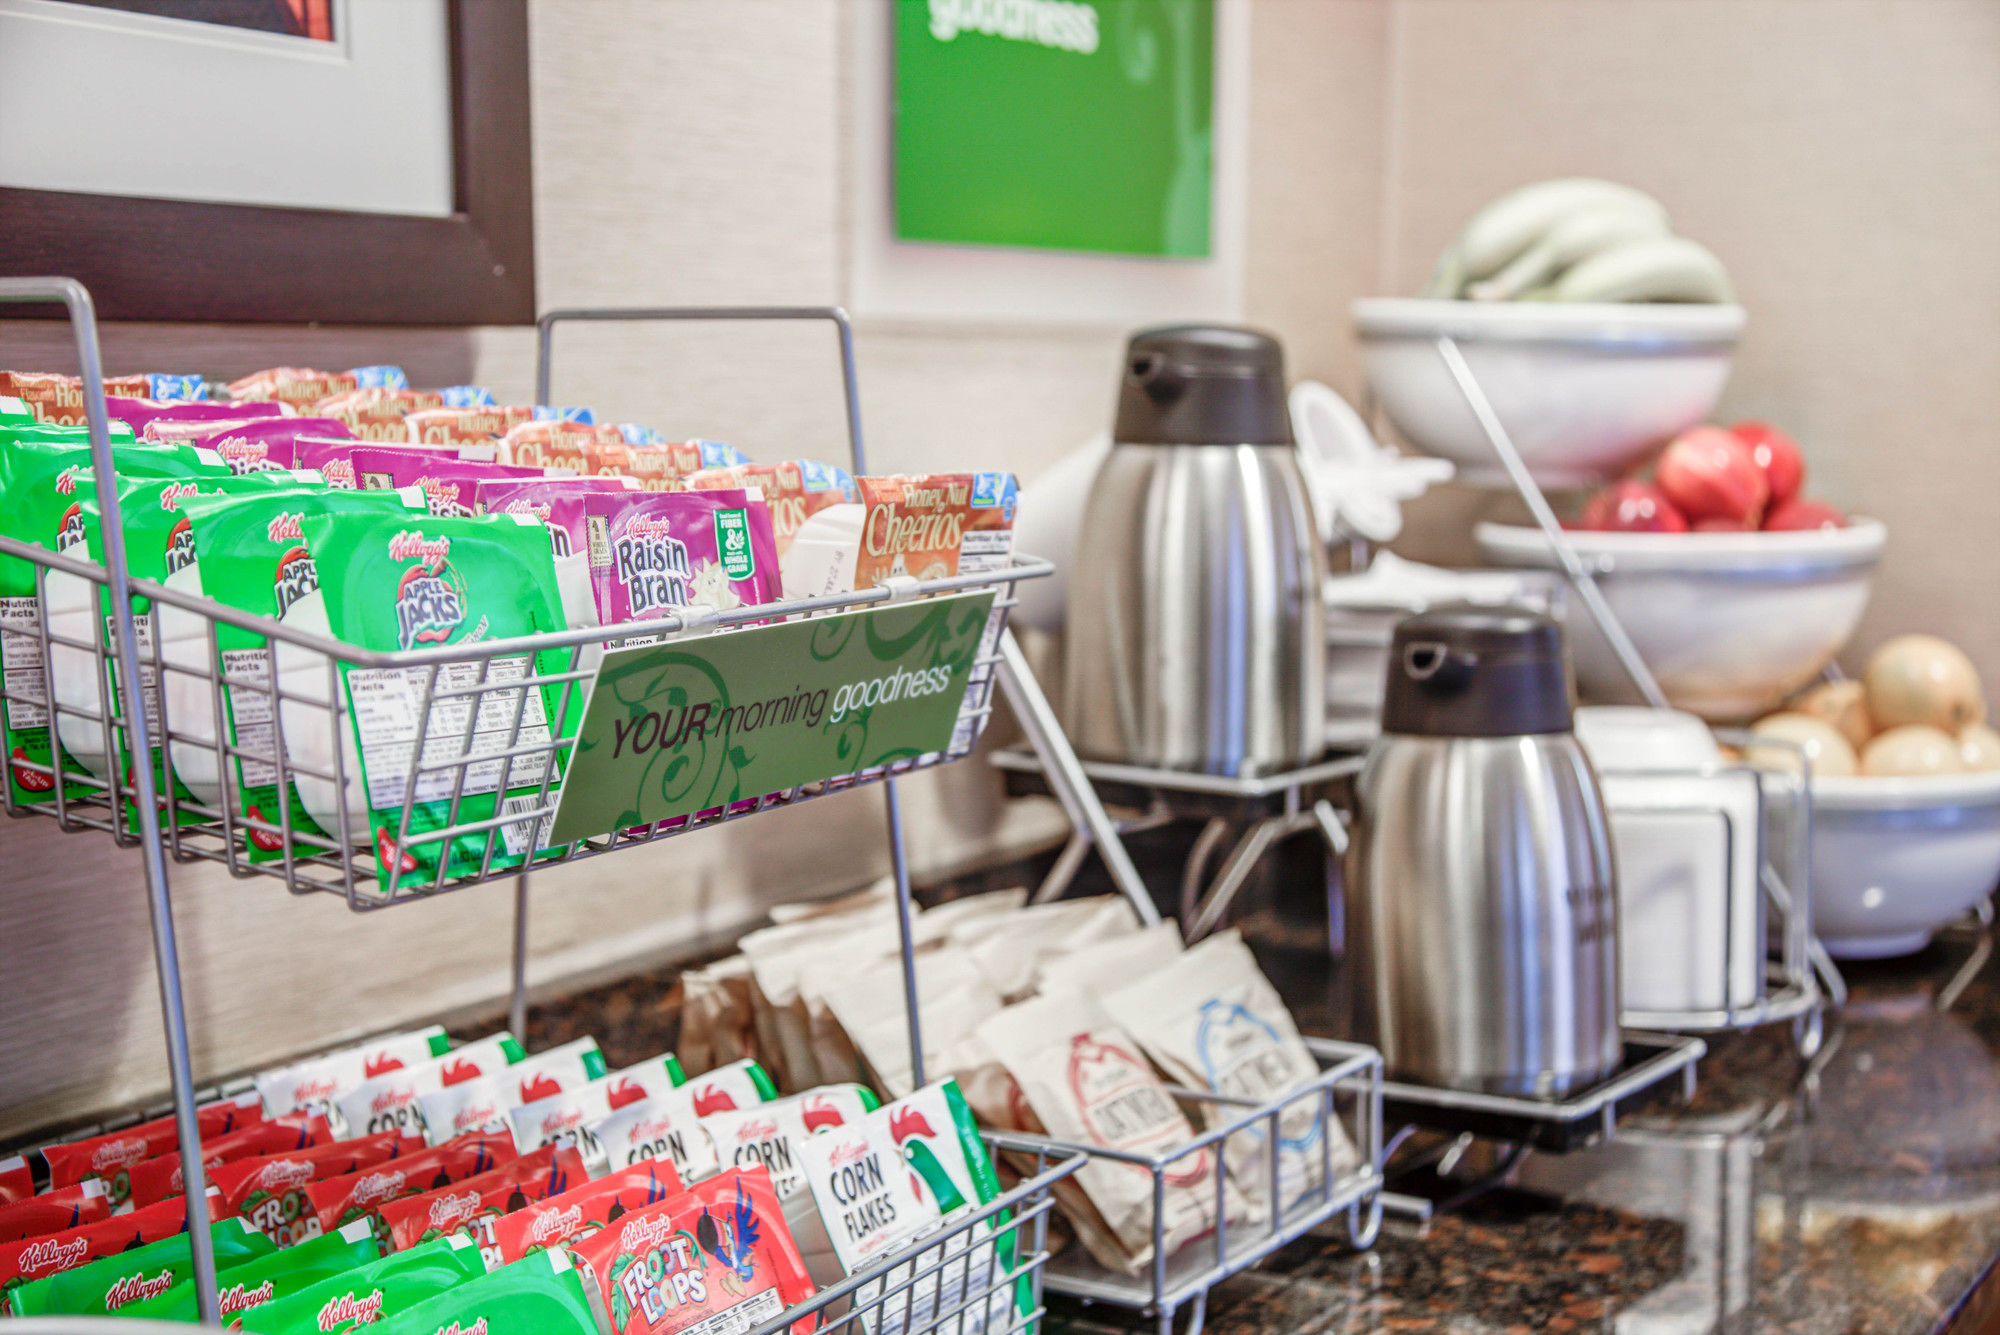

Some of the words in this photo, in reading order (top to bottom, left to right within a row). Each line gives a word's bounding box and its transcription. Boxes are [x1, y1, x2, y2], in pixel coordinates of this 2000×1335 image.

[902, 483, 944, 511] Honey
[945, 483, 970, 506] Nut
[626, 513, 669, 539] Kellogg's
[866, 502, 966, 557] Cheerios
[388, 530, 450, 566] Kellogg's
[616, 536, 691, 583] Raisin
[283, 561, 318, 583] APPL
[404, 580, 443, 600] APPLE
[1, 609, 35, 618] Facts
[630, 574, 690, 615] Bran
[397, 594, 461, 649] JACKS
[612, 703, 712, 760] YOUR
[714, 686, 829, 739] morning
[829, 664, 952, 724] goodness
[734, 1136, 792, 1173] CORN
[830, 1152, 885, 1206] CORN
[252, 1189, 313, 1230] FROO
[429, 1190, 481, 1226] Kellogg's
[532, 1204, 582, 1242] Kellogg's
[843, 1191, 897, 1243] FLAKES
[620, 1213, 671, 1250] Kellogg's
[19, 1236, 87, 1273] Kellogg's
[622, 1237, 689, 1310] FROOT
[106, 1269, 173, 1310] Kellogg's
[317, 1288, 383, 1332] Kellogg's
[640, 1268, 707, 1326] LOOPS
